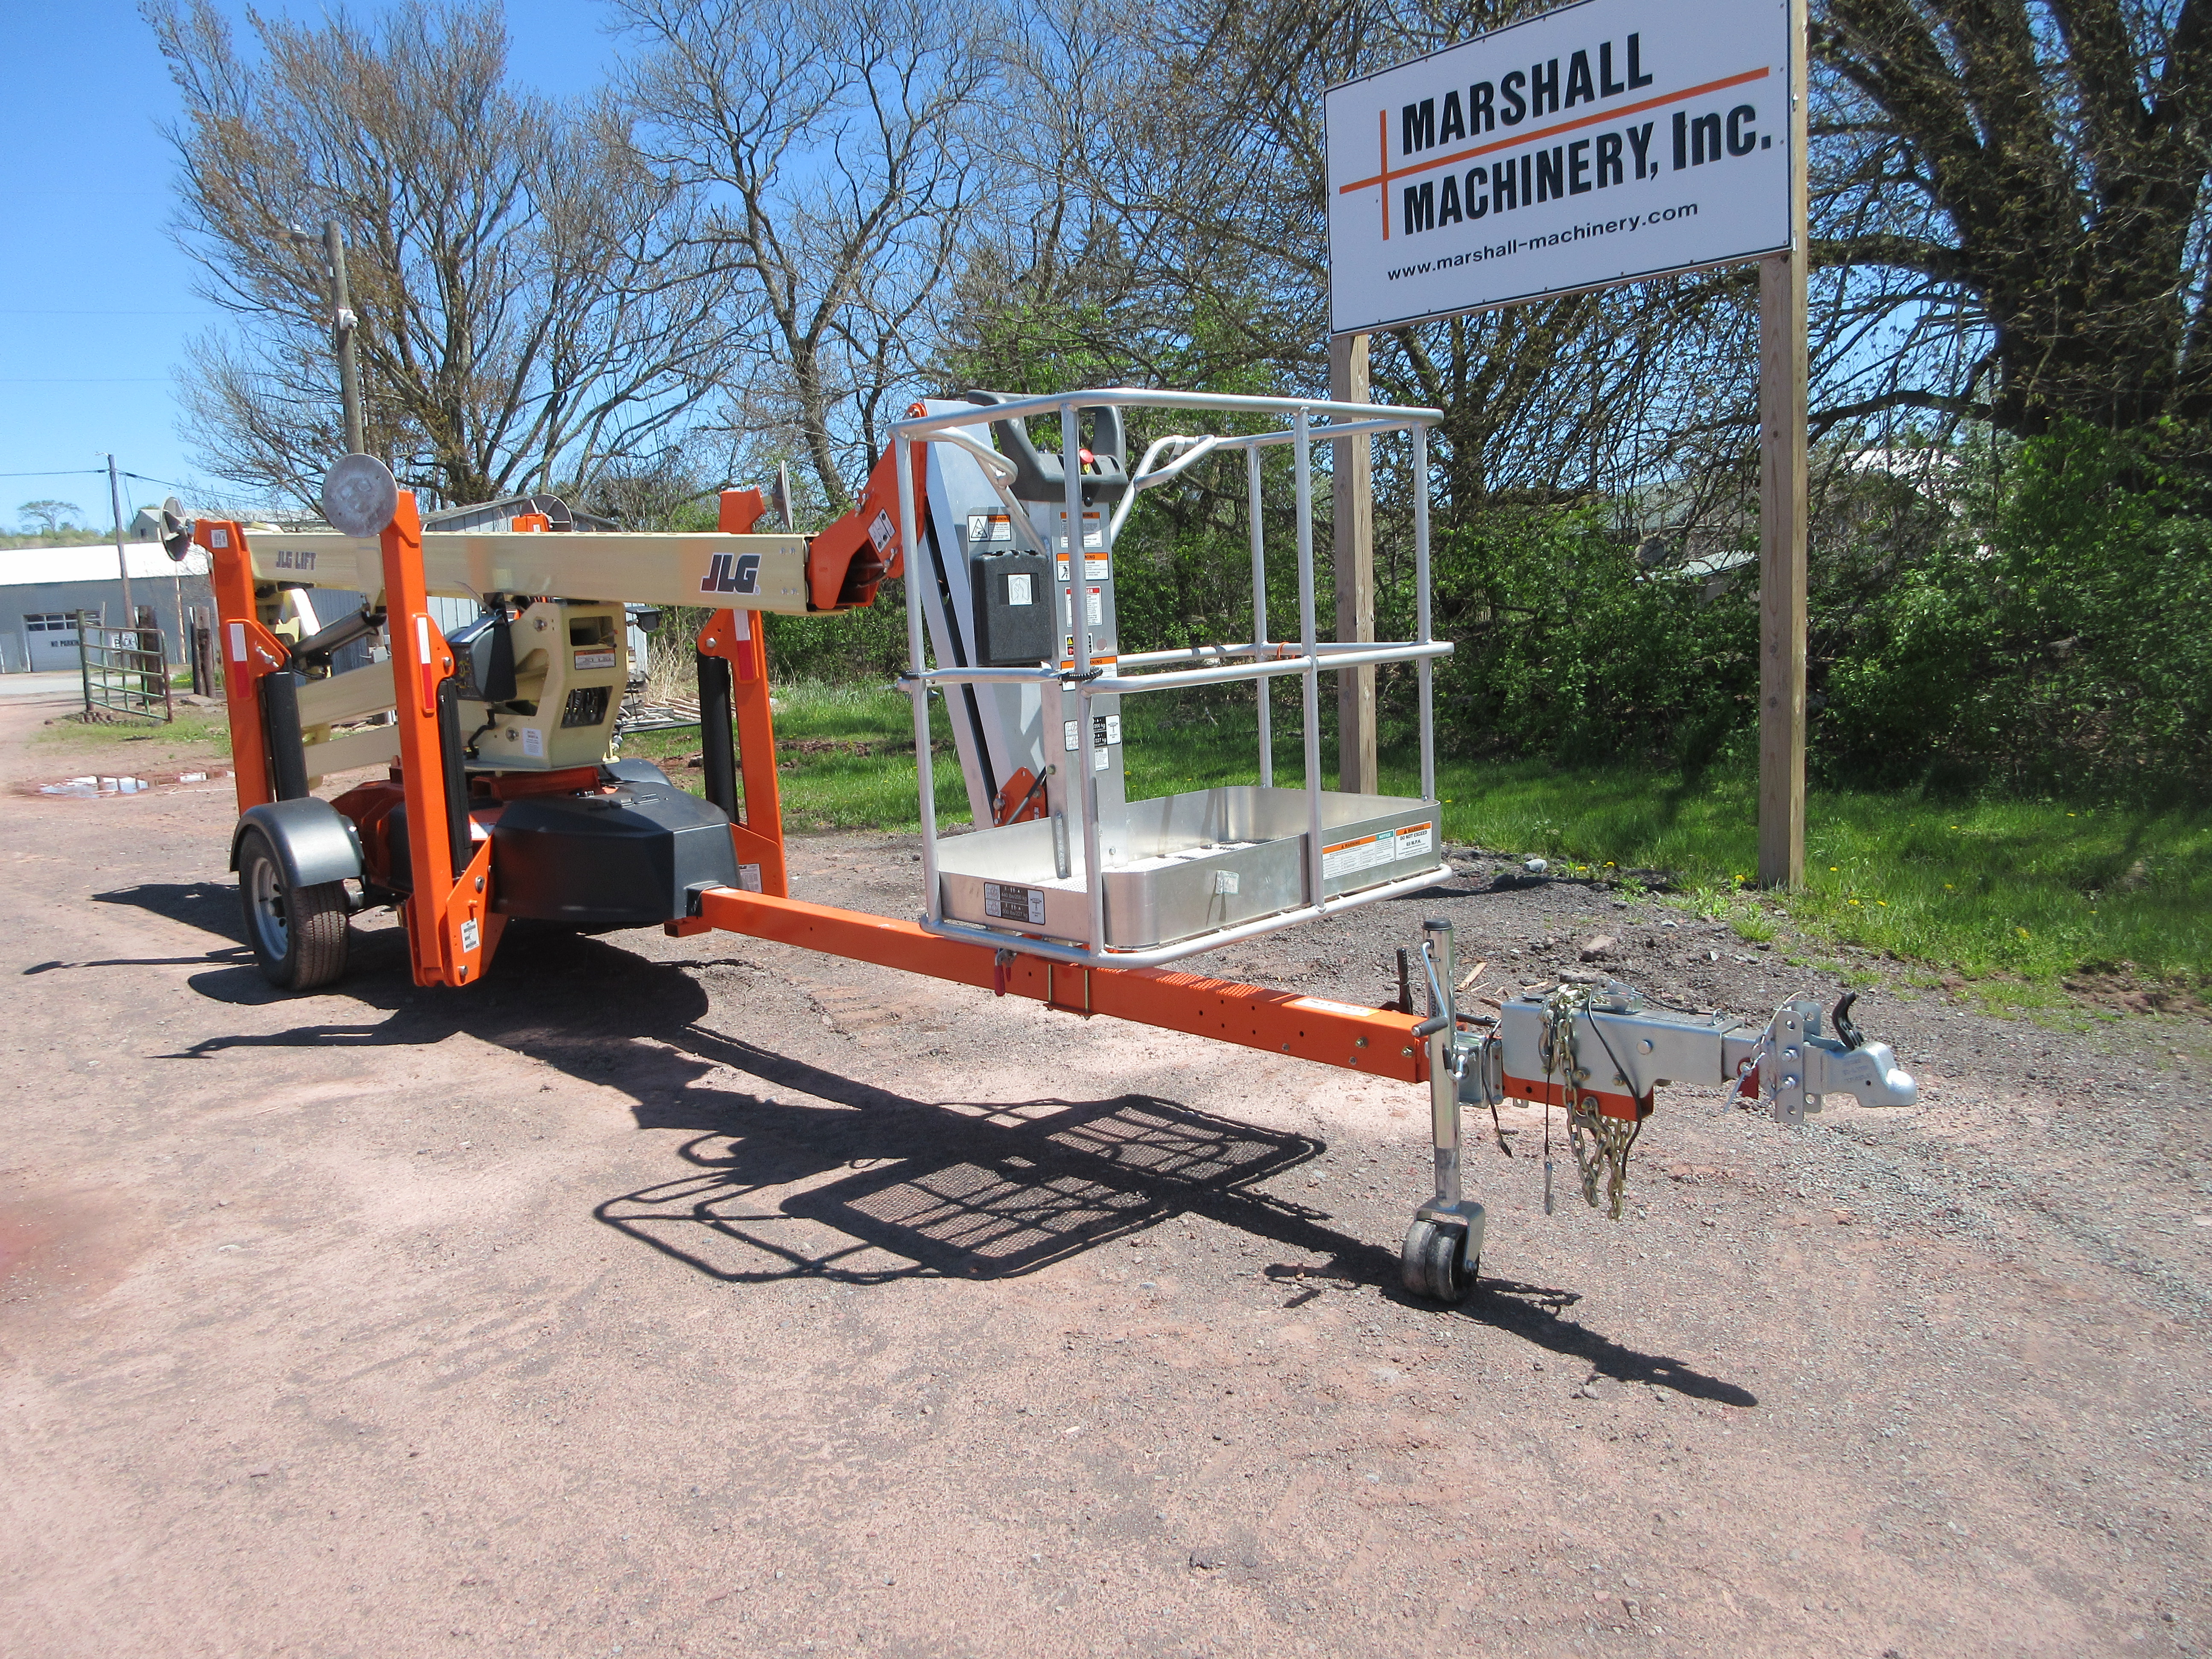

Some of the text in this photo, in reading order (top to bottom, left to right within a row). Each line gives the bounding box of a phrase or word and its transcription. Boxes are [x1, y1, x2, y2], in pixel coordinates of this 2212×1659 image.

[1403, 32, 1653, 155] MARSHALL
[1404, 105, 1771, 235] MACHINERY, Inc.
[1388, 204, 1697, 280] www.marshall-machinery.com
[276, 551, 316, 570] JLG LIFT
[701, 553, 761, 594] JLG
